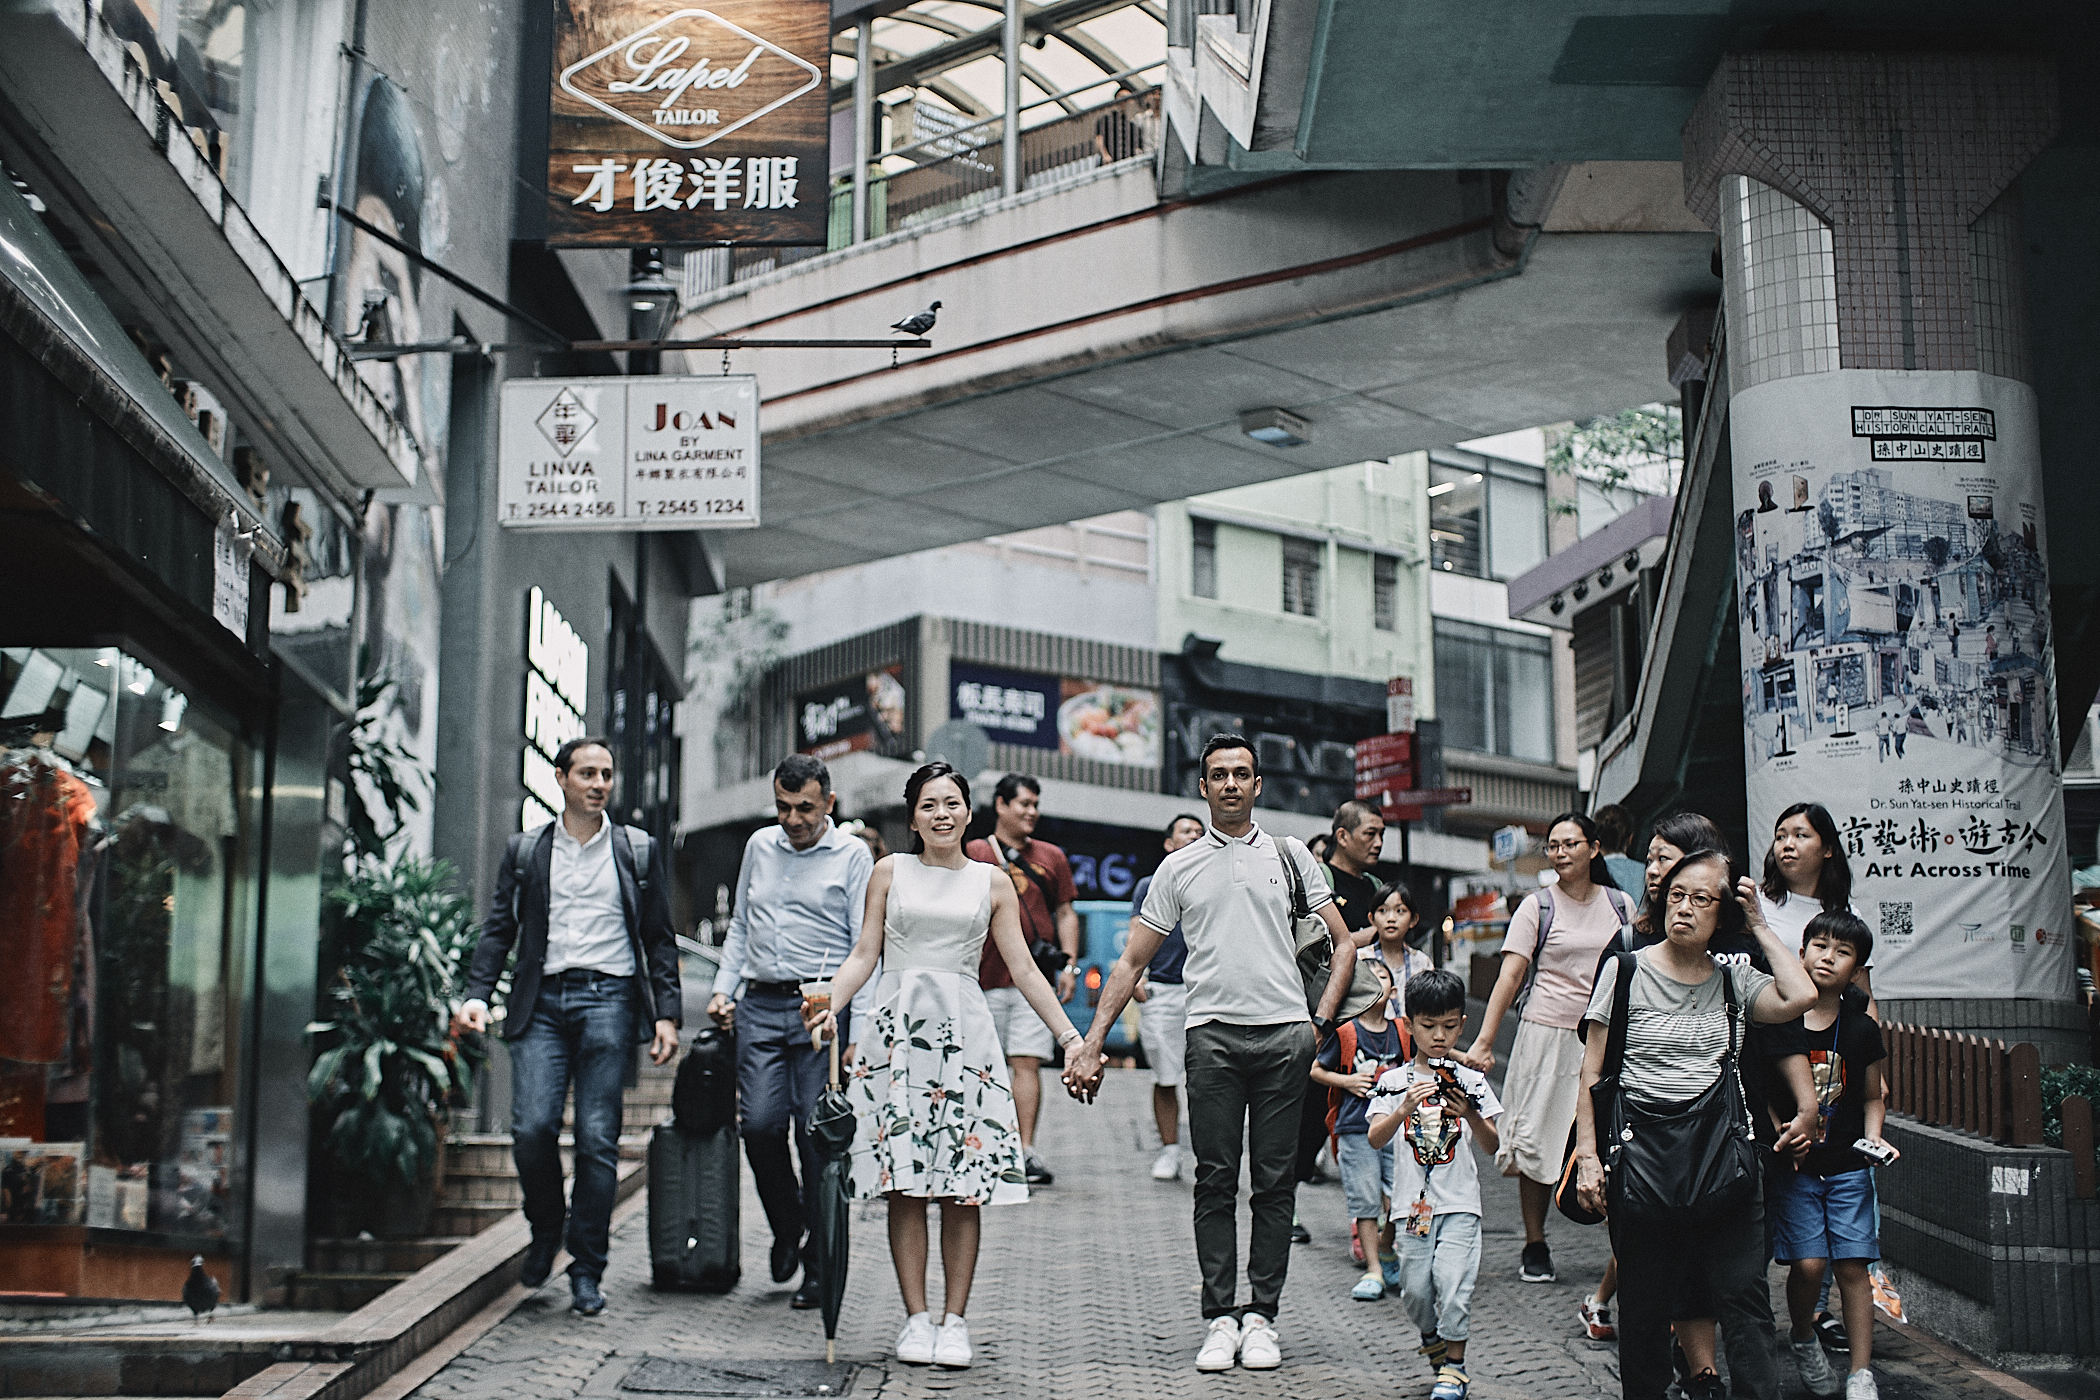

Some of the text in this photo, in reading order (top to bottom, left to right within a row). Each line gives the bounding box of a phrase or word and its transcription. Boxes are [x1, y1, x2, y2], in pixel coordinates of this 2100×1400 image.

[608, 36, 765, 109] Lapel
[652, 109, 720, 125] TAILOR
[571, 156, 800, 212] 才俊洋服
[644, 403, 737, 432] JOAN
[1864, 411, 1987, 423] DR SUN YAT-SEN
[1856, 423, 1994, 436] HISTORICAL TRAIL
[680, 436, 699, 447] BY
[635, 449, 744, 463] LINA GARMENT
[1876, 442, 1981, 458] 孫中山史蹟徑
[529, 461, 595, 478] LINVA
[525, 479, 598, 494] TAILOR
[508, 501, 615, 517] T: 2544 2456
[638, 500, 744, 515] T: 2545 1234
[1899, 777, 2000, 794] 孫中山史蹟徑
[1870, 798, 2021, 811] Dr. Sun Yat-sen Historical Trail
[1865, 862, 2030, 879] Art Across Time
